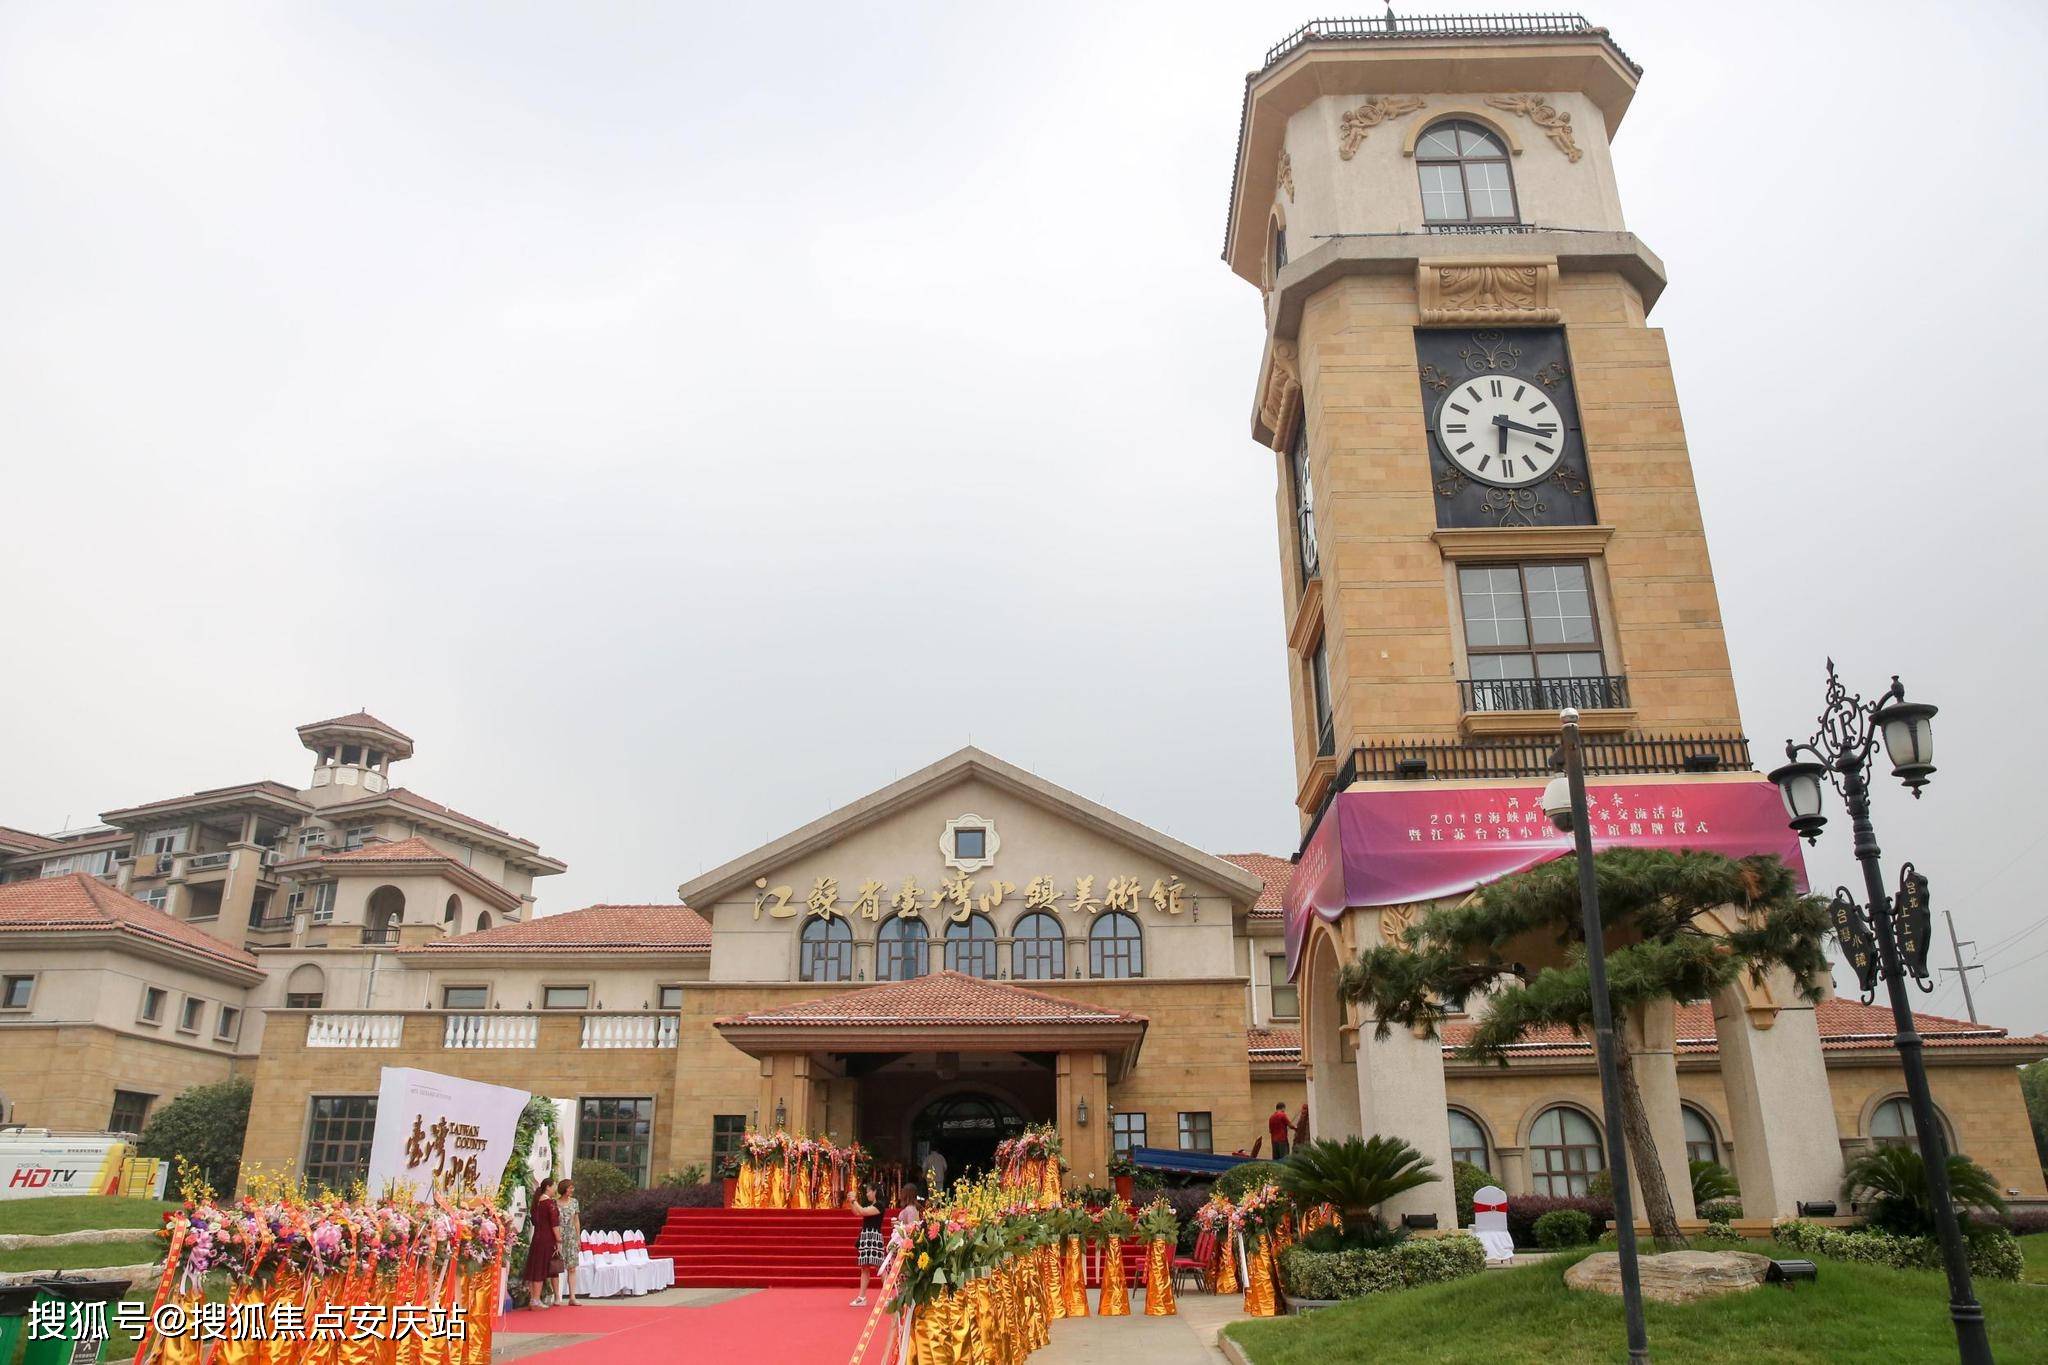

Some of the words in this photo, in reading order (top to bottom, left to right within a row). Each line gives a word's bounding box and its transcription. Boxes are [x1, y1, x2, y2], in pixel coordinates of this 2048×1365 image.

[1408, 821, 1709, 842] 暨江苏台湾小镇术馆揭牌仪式
[450, 1122, 480, 1137] TAIWAN
[455, 1136, 488, 1151] COUNTY
